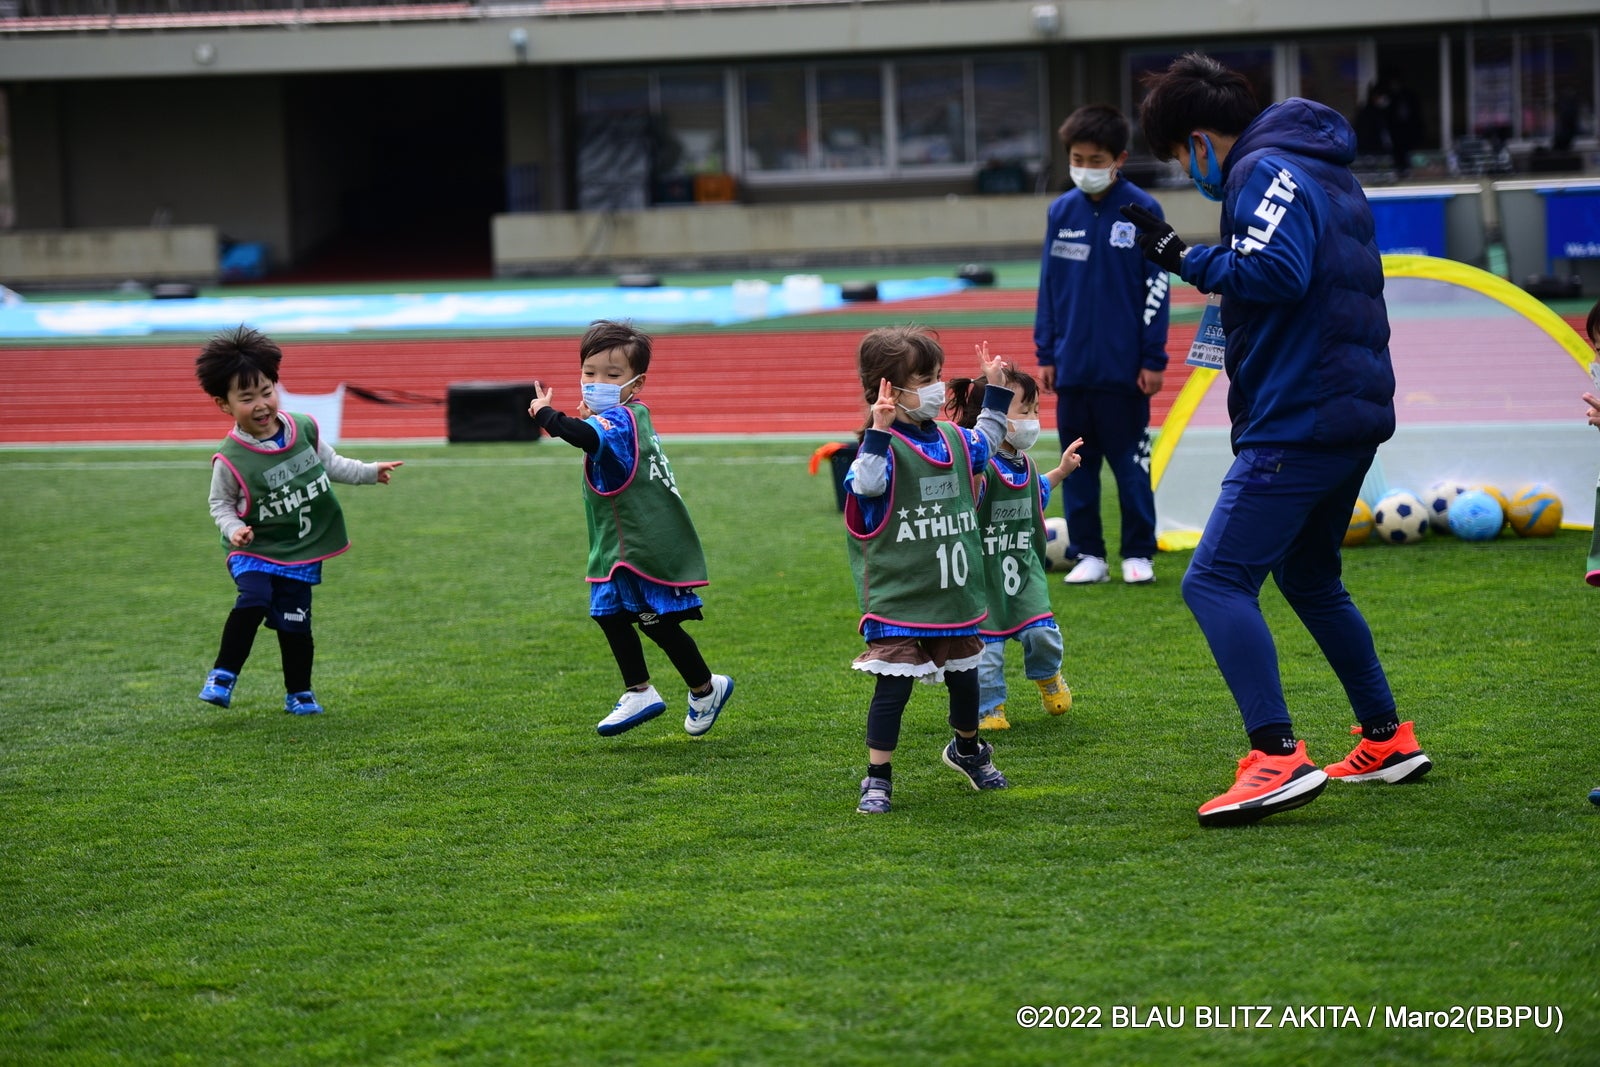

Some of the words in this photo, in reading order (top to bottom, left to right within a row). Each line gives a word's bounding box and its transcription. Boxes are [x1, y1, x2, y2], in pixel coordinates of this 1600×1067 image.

[298, 505, 312, 539] 5
[936, 541, 969, 589] 10
[1002, 555, 1021, 596] 8
